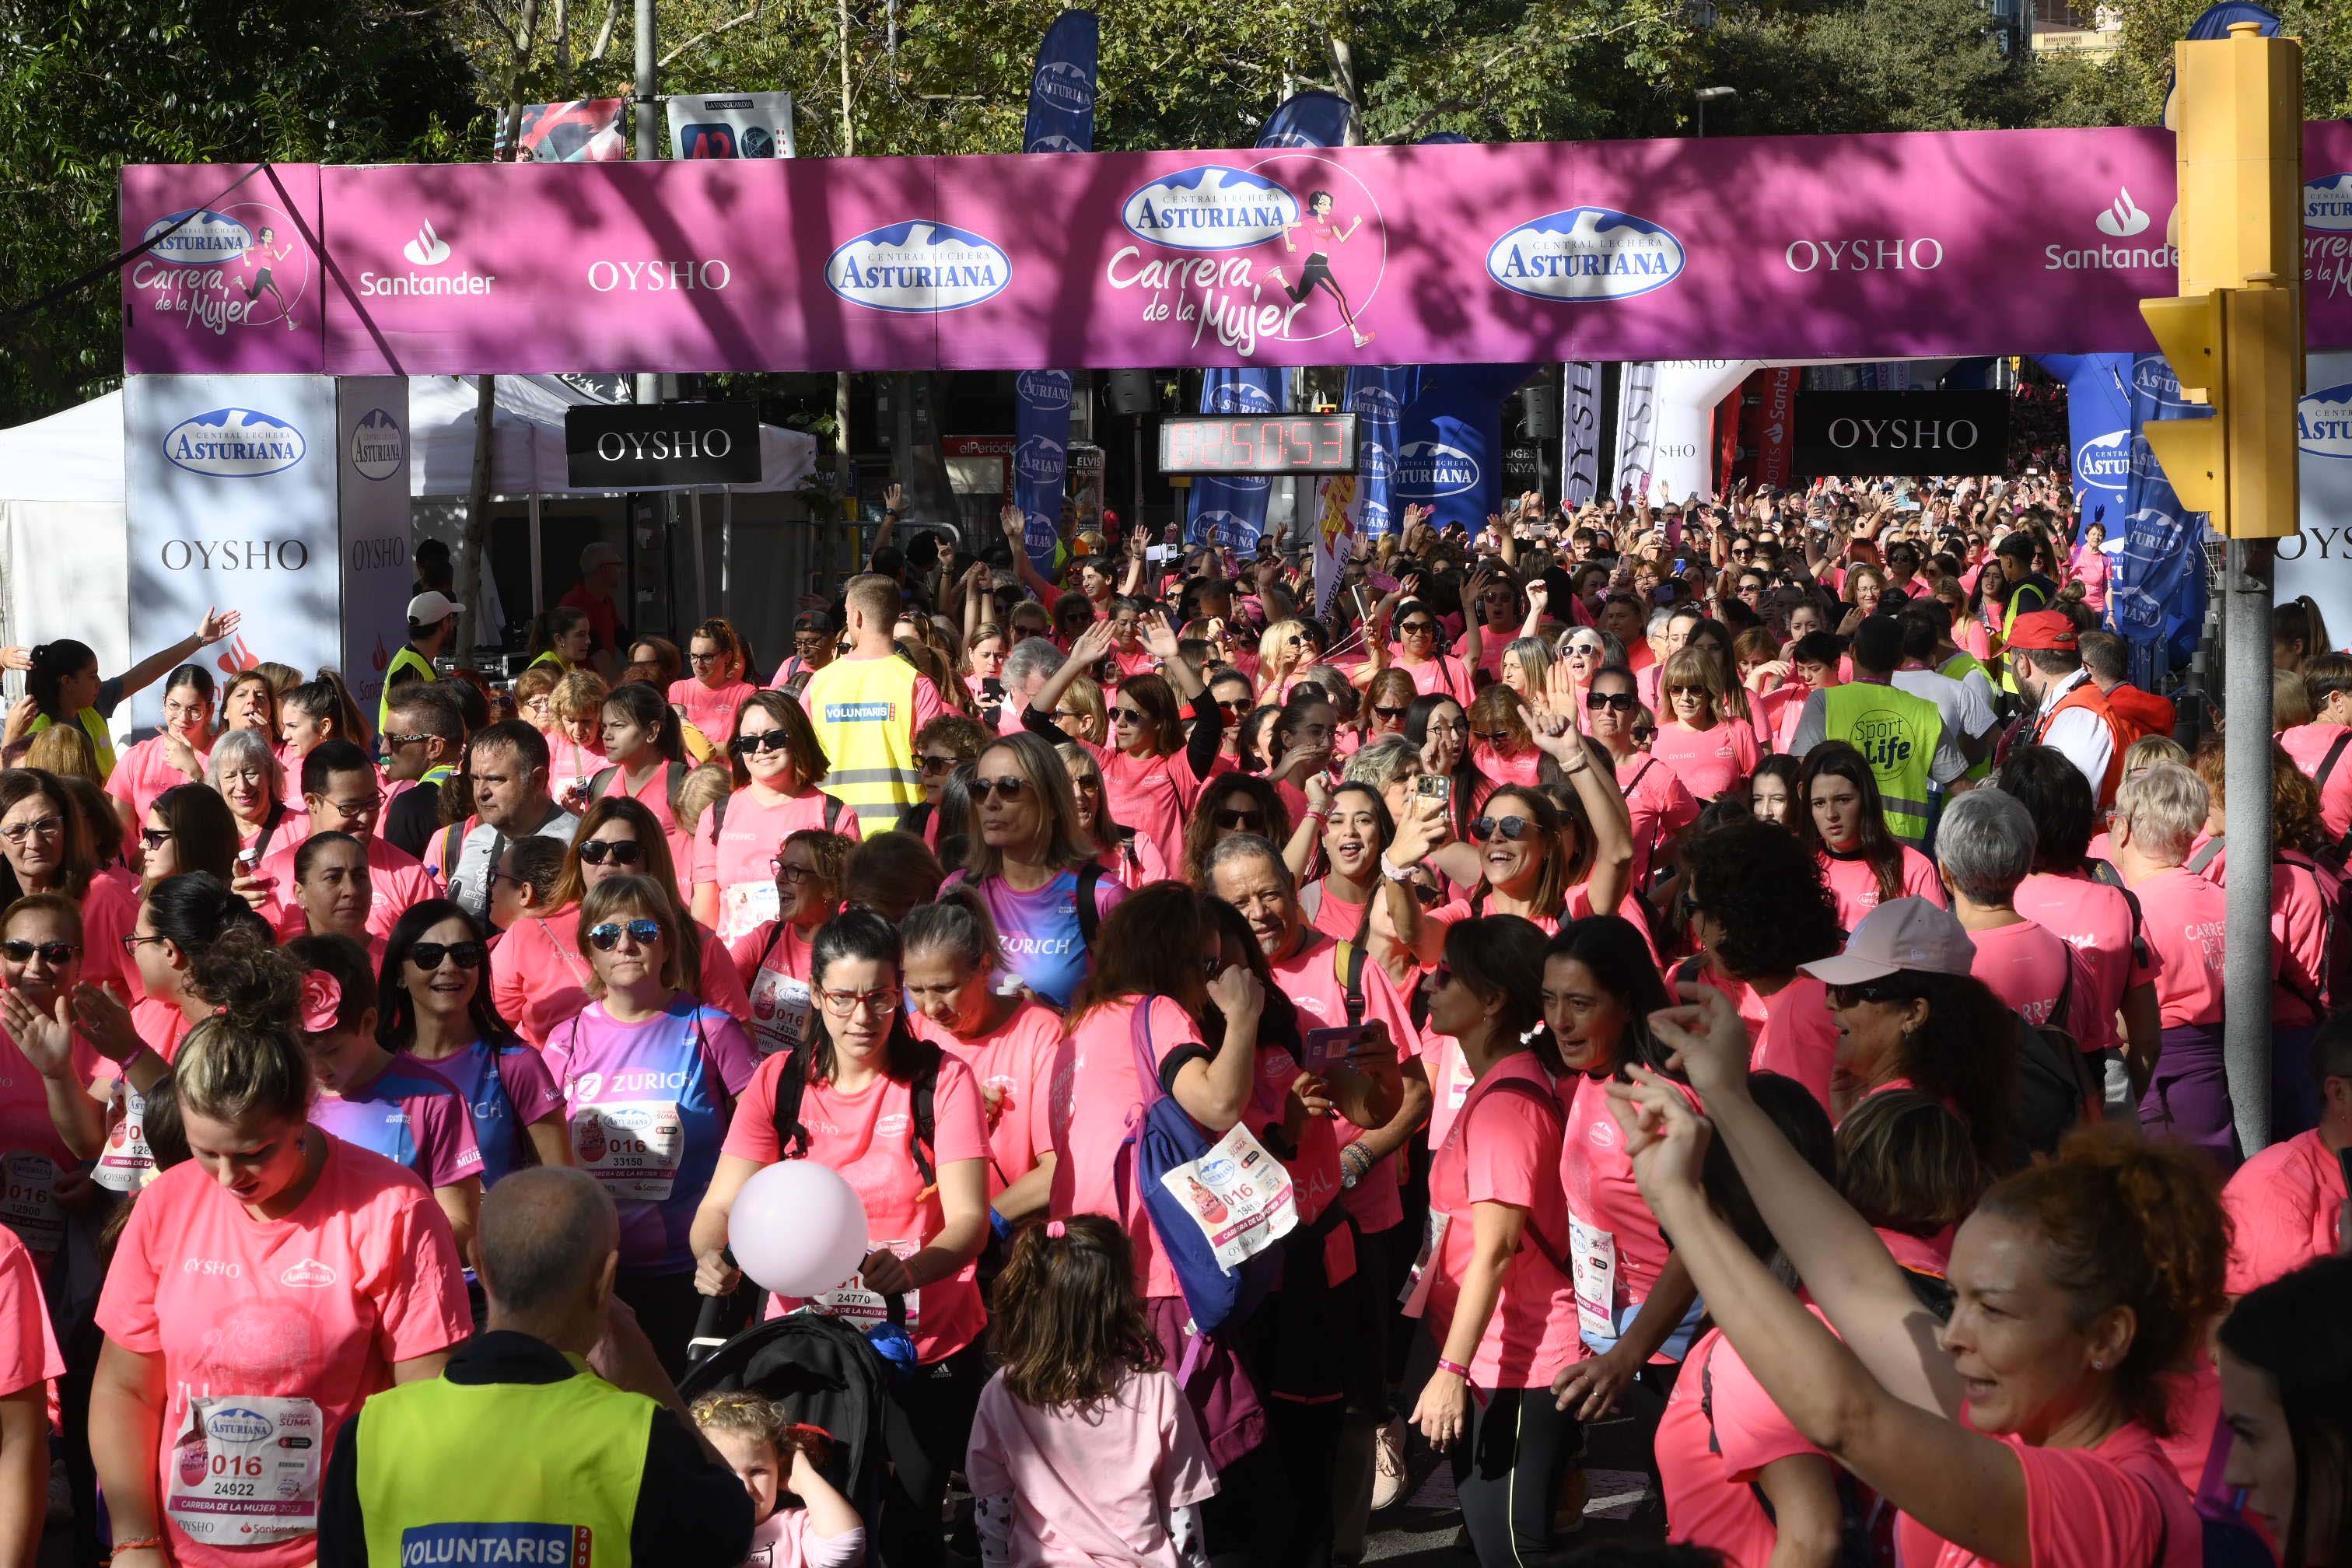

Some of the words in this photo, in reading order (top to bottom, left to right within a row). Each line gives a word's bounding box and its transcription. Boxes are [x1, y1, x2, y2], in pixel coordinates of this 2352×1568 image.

[1039, 76, 1091, 105] ASTURIANA
[1163, 194, 1218, 205] CENTRAL
[1223, 193, 1280, 203] LECHERA
[1136, 197, 1284, 230] ASTURIANA
[1532, 240, 1593, 250] CENTRAL
[1600, 237, 1663, 248] LECHERA
[1786, 236, 1944, 272] OYSHO
[867, 253, 925, 261] CENTRAL
[1106, 245, 1252, 290] Carrera
[1503, 243, 1669, 278] ASTURIANA
[2045, 243, 2179, 270] Santande
[132, 261, 227, 291] Carrera
[587, 259, 731, 292] OYSHO
[839, 254, 997, 289] ASTURIANA
[2317, 259, 2331, 281] la
[360, 271, 495, 297] Santander
[156, 290, 173, 312] de
[176, 291, 188, 312] la
[185, 285, 261, 335] Mujer
[1143, 292, 1170, 321] de
[1175, 291, 1195, 321] la
[1191, 282, 1307, 357] Mujer
[1170, 422, 1344, 466] 02:50:53
[1829, 417, 1979, 450] OYSHO
[175, 433, 296, 460] ASTURIANA
[355, 435, 401, 463] ASTURIANA
[597, 429, 732, 463] OYSHO
[1076, 457, 1101, 467] ELVIS
[1398, 469, 1472, 484] TURIANA
[161, 540, 309, 572] OYSHO
[352, 535, 404, 572] OYSHO
[827, 705, 887, 719] VOLUNTARIS
[1856, 717, 1905, 741] Sport
[1864, 736, 1911, 770] Life
[998, 935, 1070, 954] ZURICH
[2201, 939, 2217, 954] DE
[776, 1008, 804, 1027] 016
[776, 1023, 798, 1037] 24330
[611, 1070, 694, 1093] ZURICH
[610, 1139, 646, 1153] 016
[457, 1150, 482, 1168] MUJE
[613, 1157, 642, 1167] 33150
[9, 1184, 48, 1204] 016
[1223, 1183, 1254, 1206] 016
[184, 1257, 240, 1279] OYSHO
[837, 1293, 871, 1304] 24770
[211, 1419, 268, 1436] ASTURIANA
[279, 1418, 311, 1426] SUMA
[212, 1454, 263, 1476] 016
[214, 1482, 254, 1496] 24922
[181, 1500, 215, 1511] CARRERA
[217, 1503, 229, 1511] DE
[230, 1503, 242, 1512] LA
[243, 1503, 276, 1513] MUJER
[279, 1504, 302, 1513] 2023
[401, 1538, 566, 1568] VOLUNTARIS
